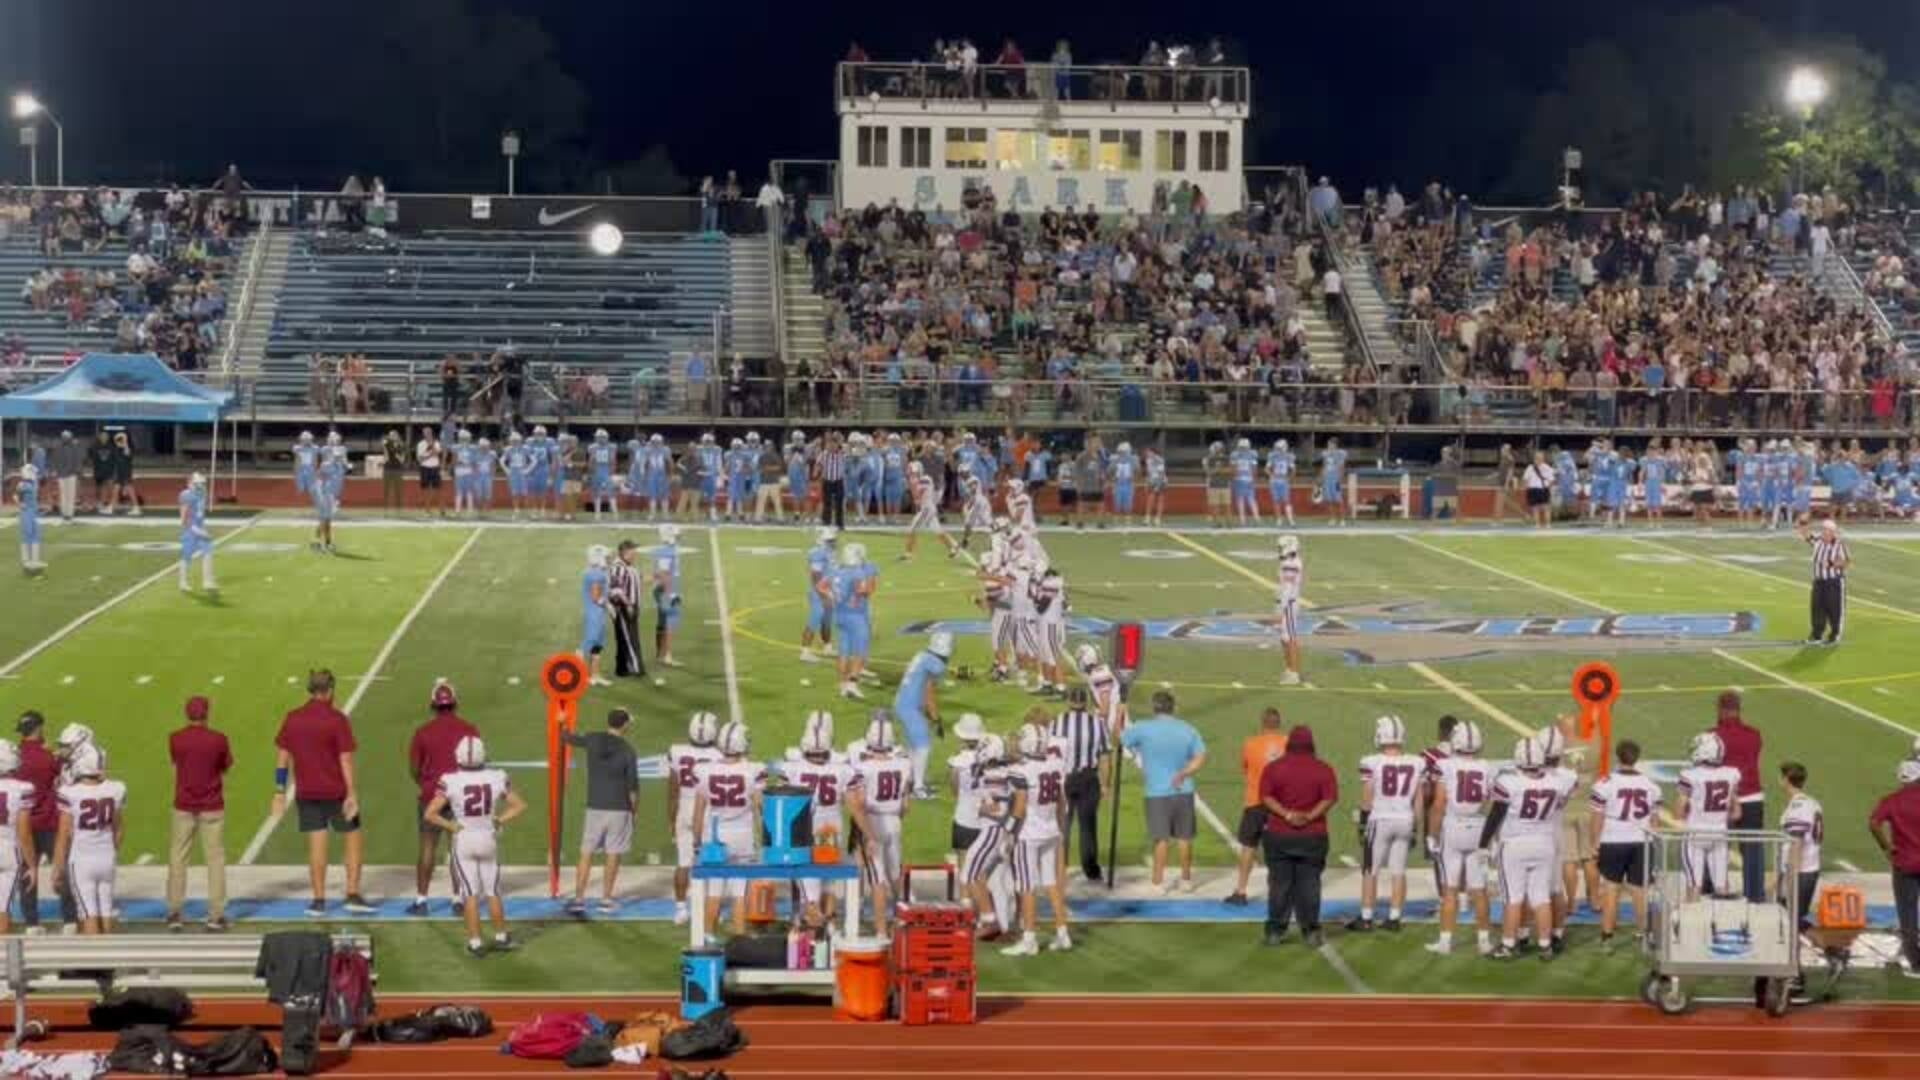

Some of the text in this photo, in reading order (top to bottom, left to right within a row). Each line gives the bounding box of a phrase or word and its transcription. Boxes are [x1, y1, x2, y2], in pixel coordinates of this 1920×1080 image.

[915, 175, 1172, 207] SARK
[1119, 624, 1139, 669] 1
[708, 774, 747, 808] 52
[877, 770, 902, 801] 81
[1038, 771, 1062, 806] 86
[1381, 764, 1415, 797] 87
[1456, 769, 1484, 804] 16
[1704, 780, 1729, 813] 12
[79, 797, 115, 830] 20
[463, 783, 493, 817] 21
[1519, 788, 1557, 821] 67
[1616, 787, 1650, 821] 75
[1827, 890, 1860, 923] 50
